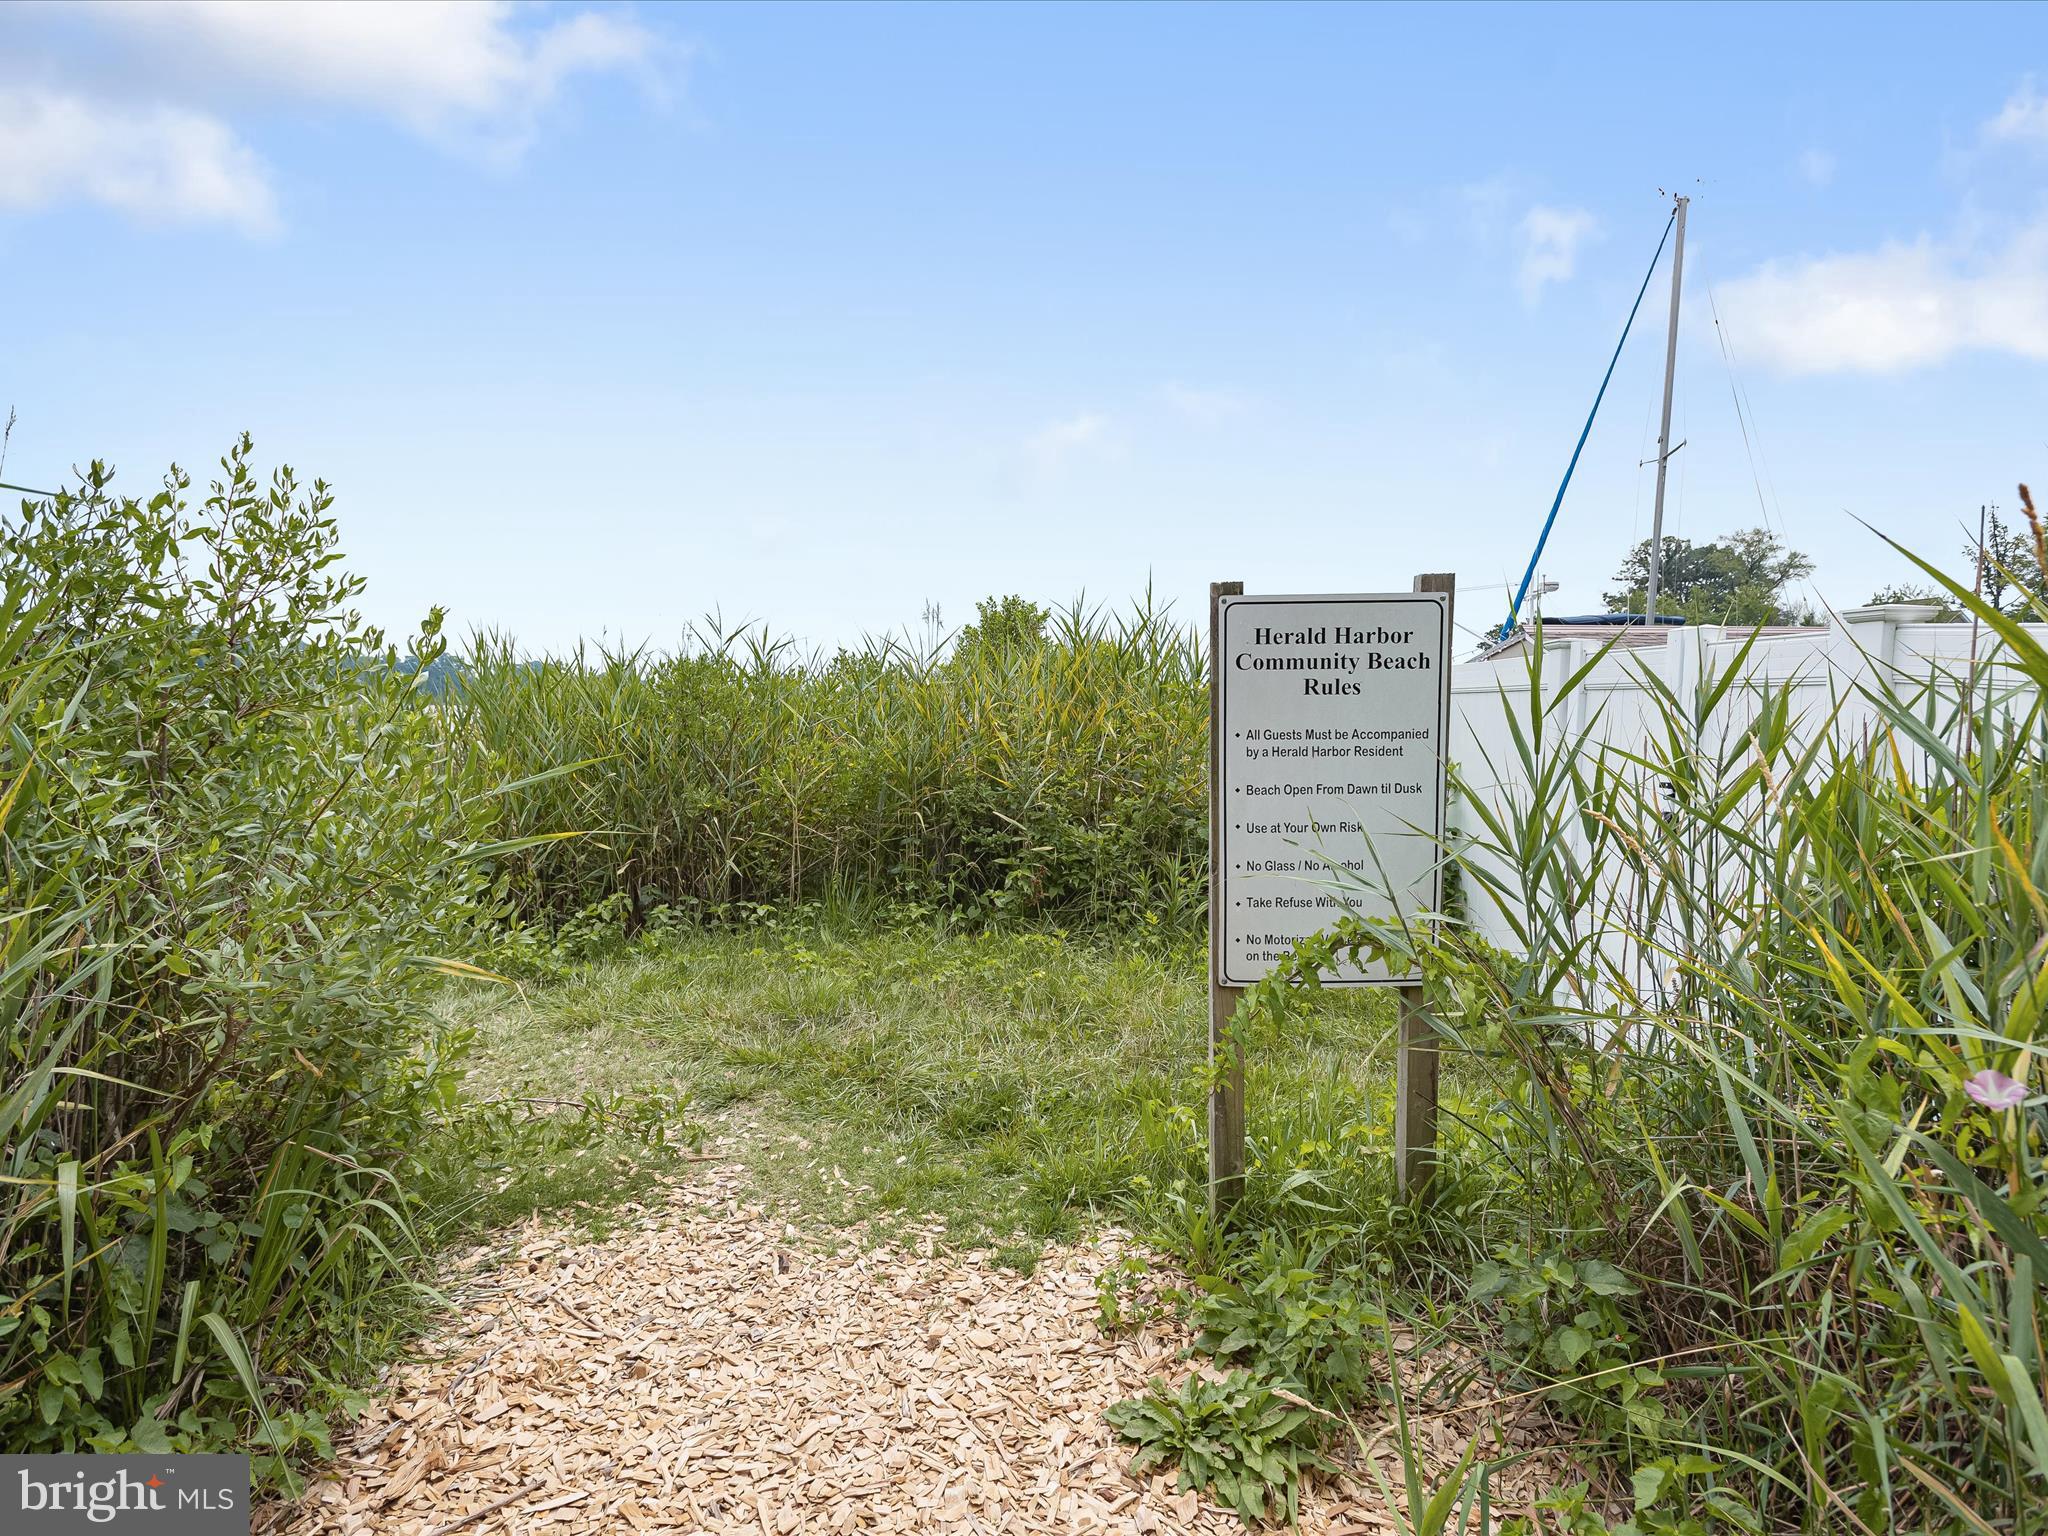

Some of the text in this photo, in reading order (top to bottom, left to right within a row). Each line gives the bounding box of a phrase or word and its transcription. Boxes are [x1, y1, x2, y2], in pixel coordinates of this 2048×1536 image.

[1254, 626, 1414, 645] Herald Harbor
[1235, 651, 1431, 675] Community Beach
[1303, 678, 1361, 696] Rules
[1246, 727, 1429, 743] All Guests Must be Accompanied
[1246, 744, 1404, 760] by a Herald Harbor Resident
[1246, 782, 1423, 798] Beach Open From Dawn til Dusk
[1246, 821, 1363, 834] Use at Your Own Risk
[1246, 859, 1364, 872] No Glass / No Aohol
[1246, 896, 1273, 908] Take
[1275, 896, 1313, 908] Refuse
[1342, 896, 1363, 908] You
[1246, 934, 1262, 945] No
[1264, 933, 1315, 946] Motoriz
[1246, 952, 1260, 962] on
[1262, 950, 1280, 962] the
